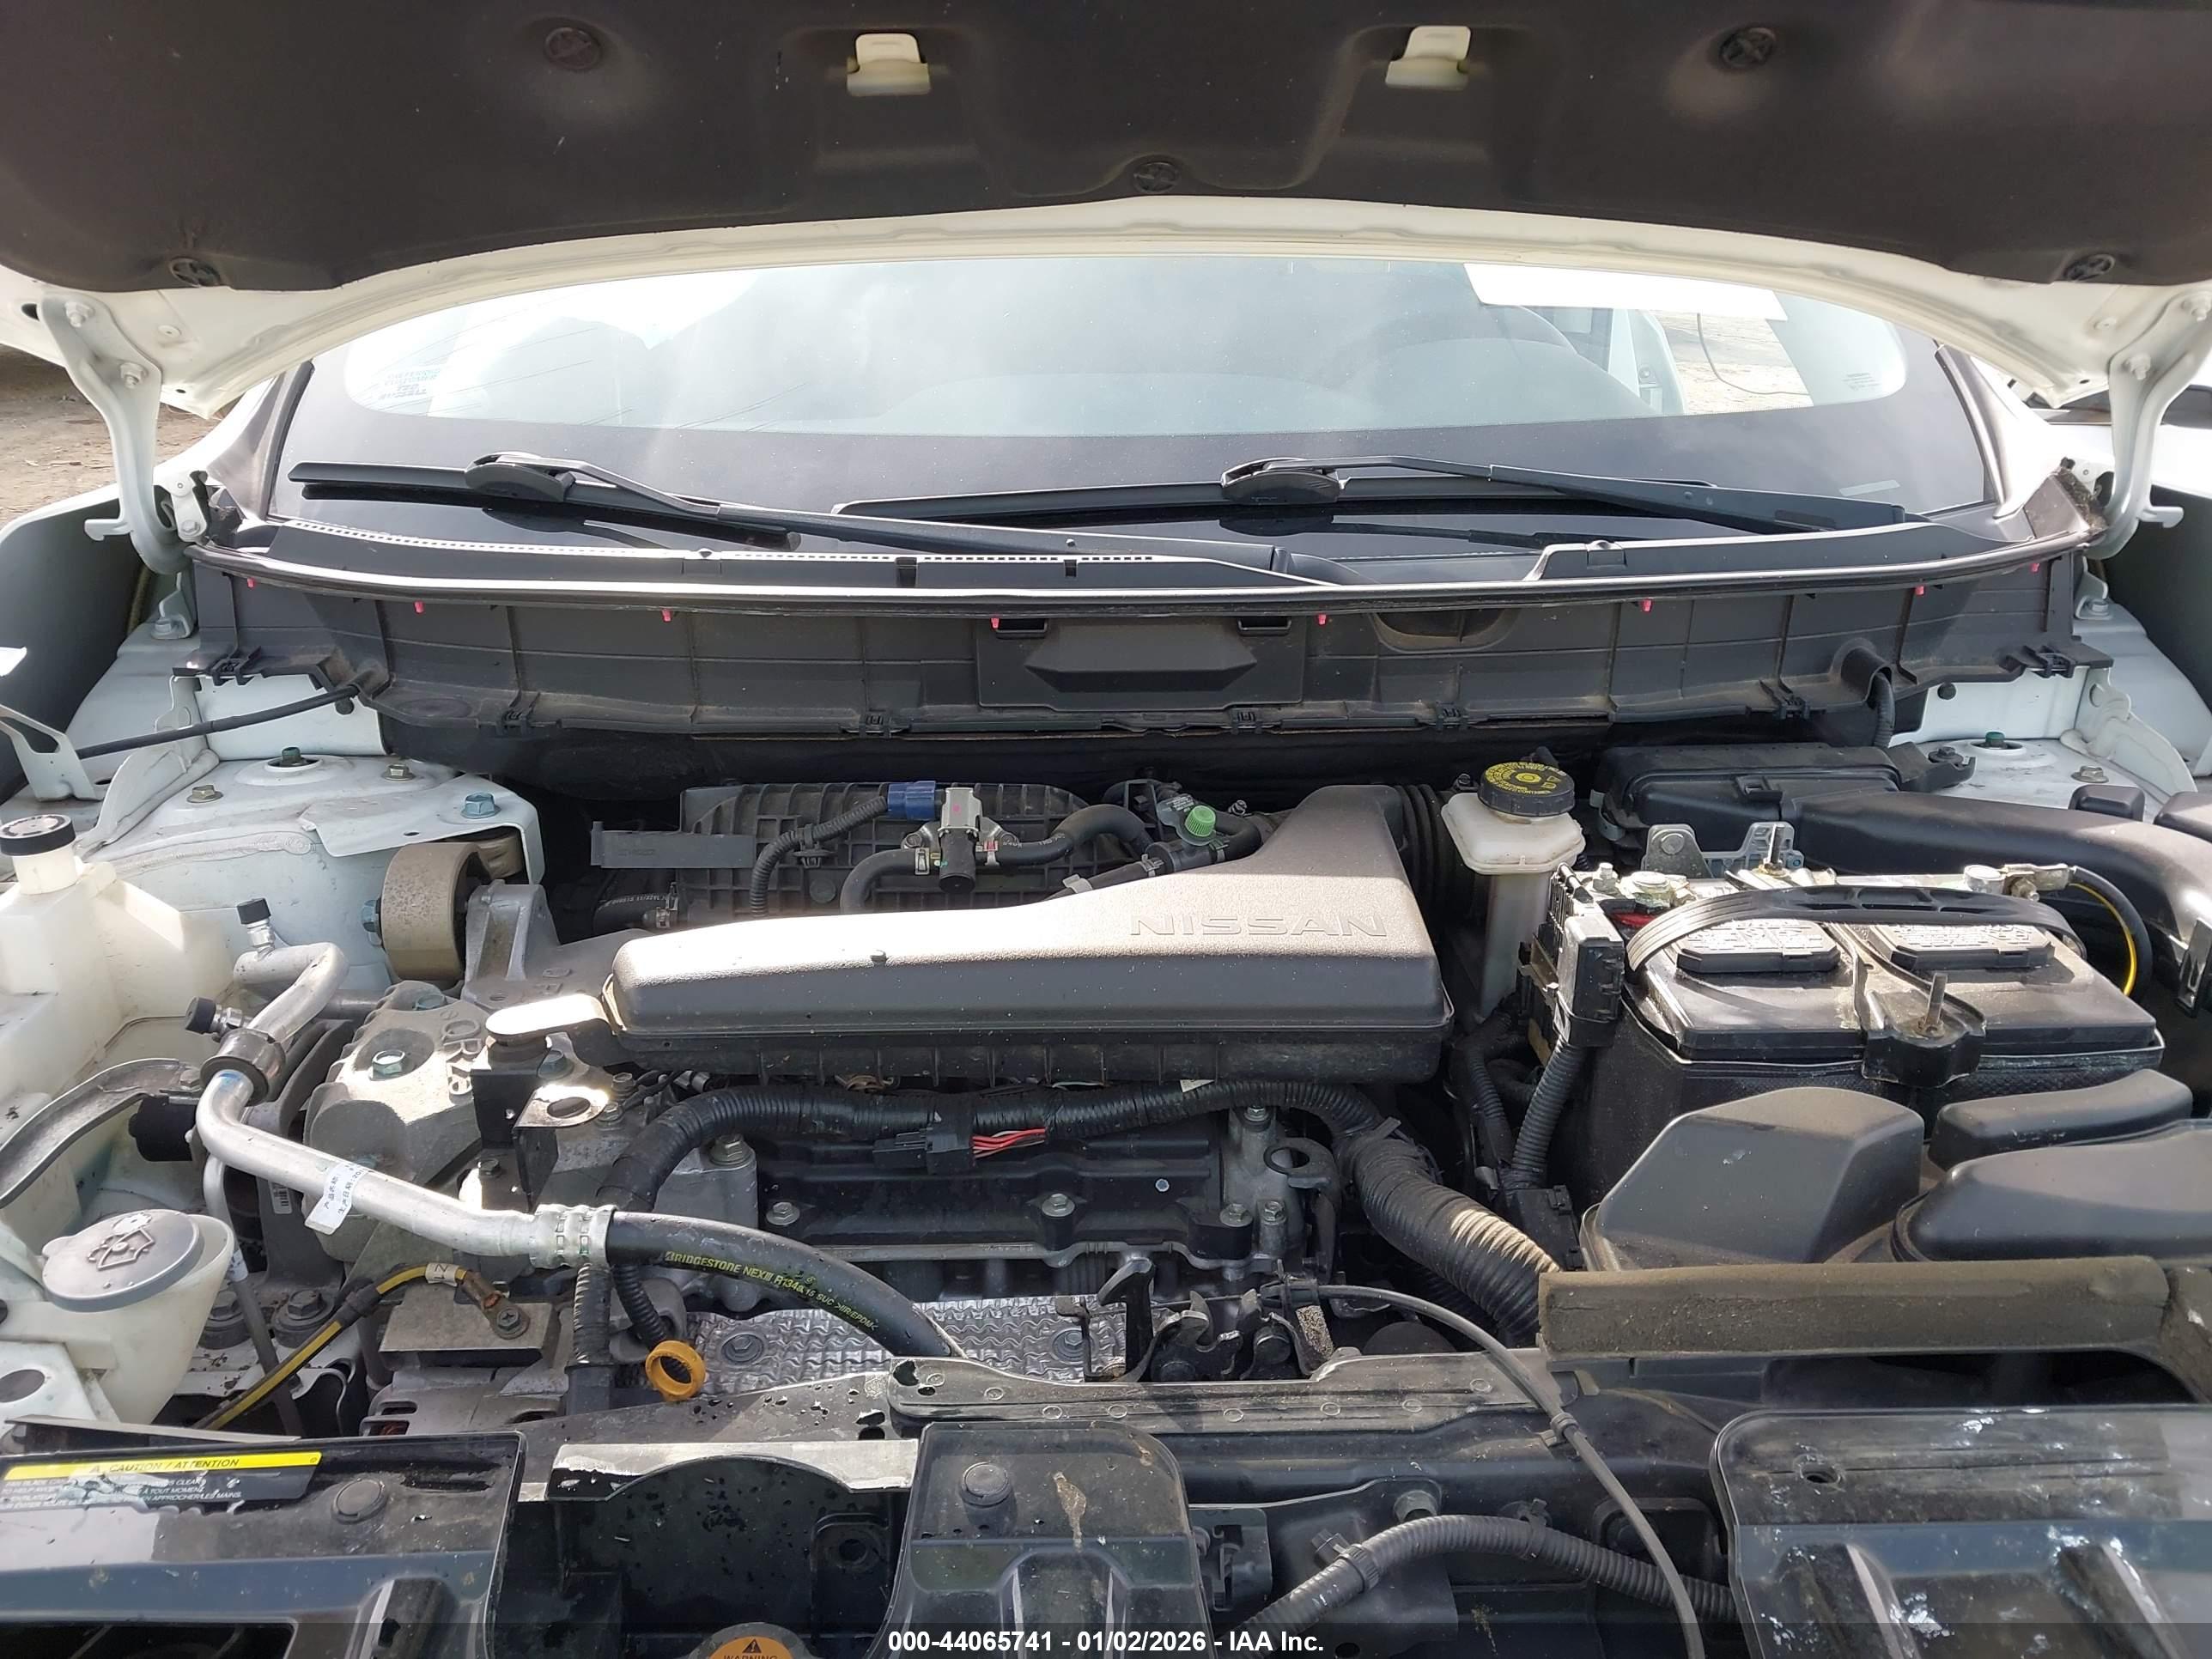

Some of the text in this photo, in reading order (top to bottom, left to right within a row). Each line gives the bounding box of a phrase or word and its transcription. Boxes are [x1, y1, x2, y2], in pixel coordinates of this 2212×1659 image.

[1130, 914, 1388, 937] NISSAN
[665, 1251, 742, 1273] BRIDGESTONE
[816, 1294, 835, 1305] SUC
[109, 1462, 162, 1473] CAUTION
[173, 1458, 240, 1470] ATTENTION
